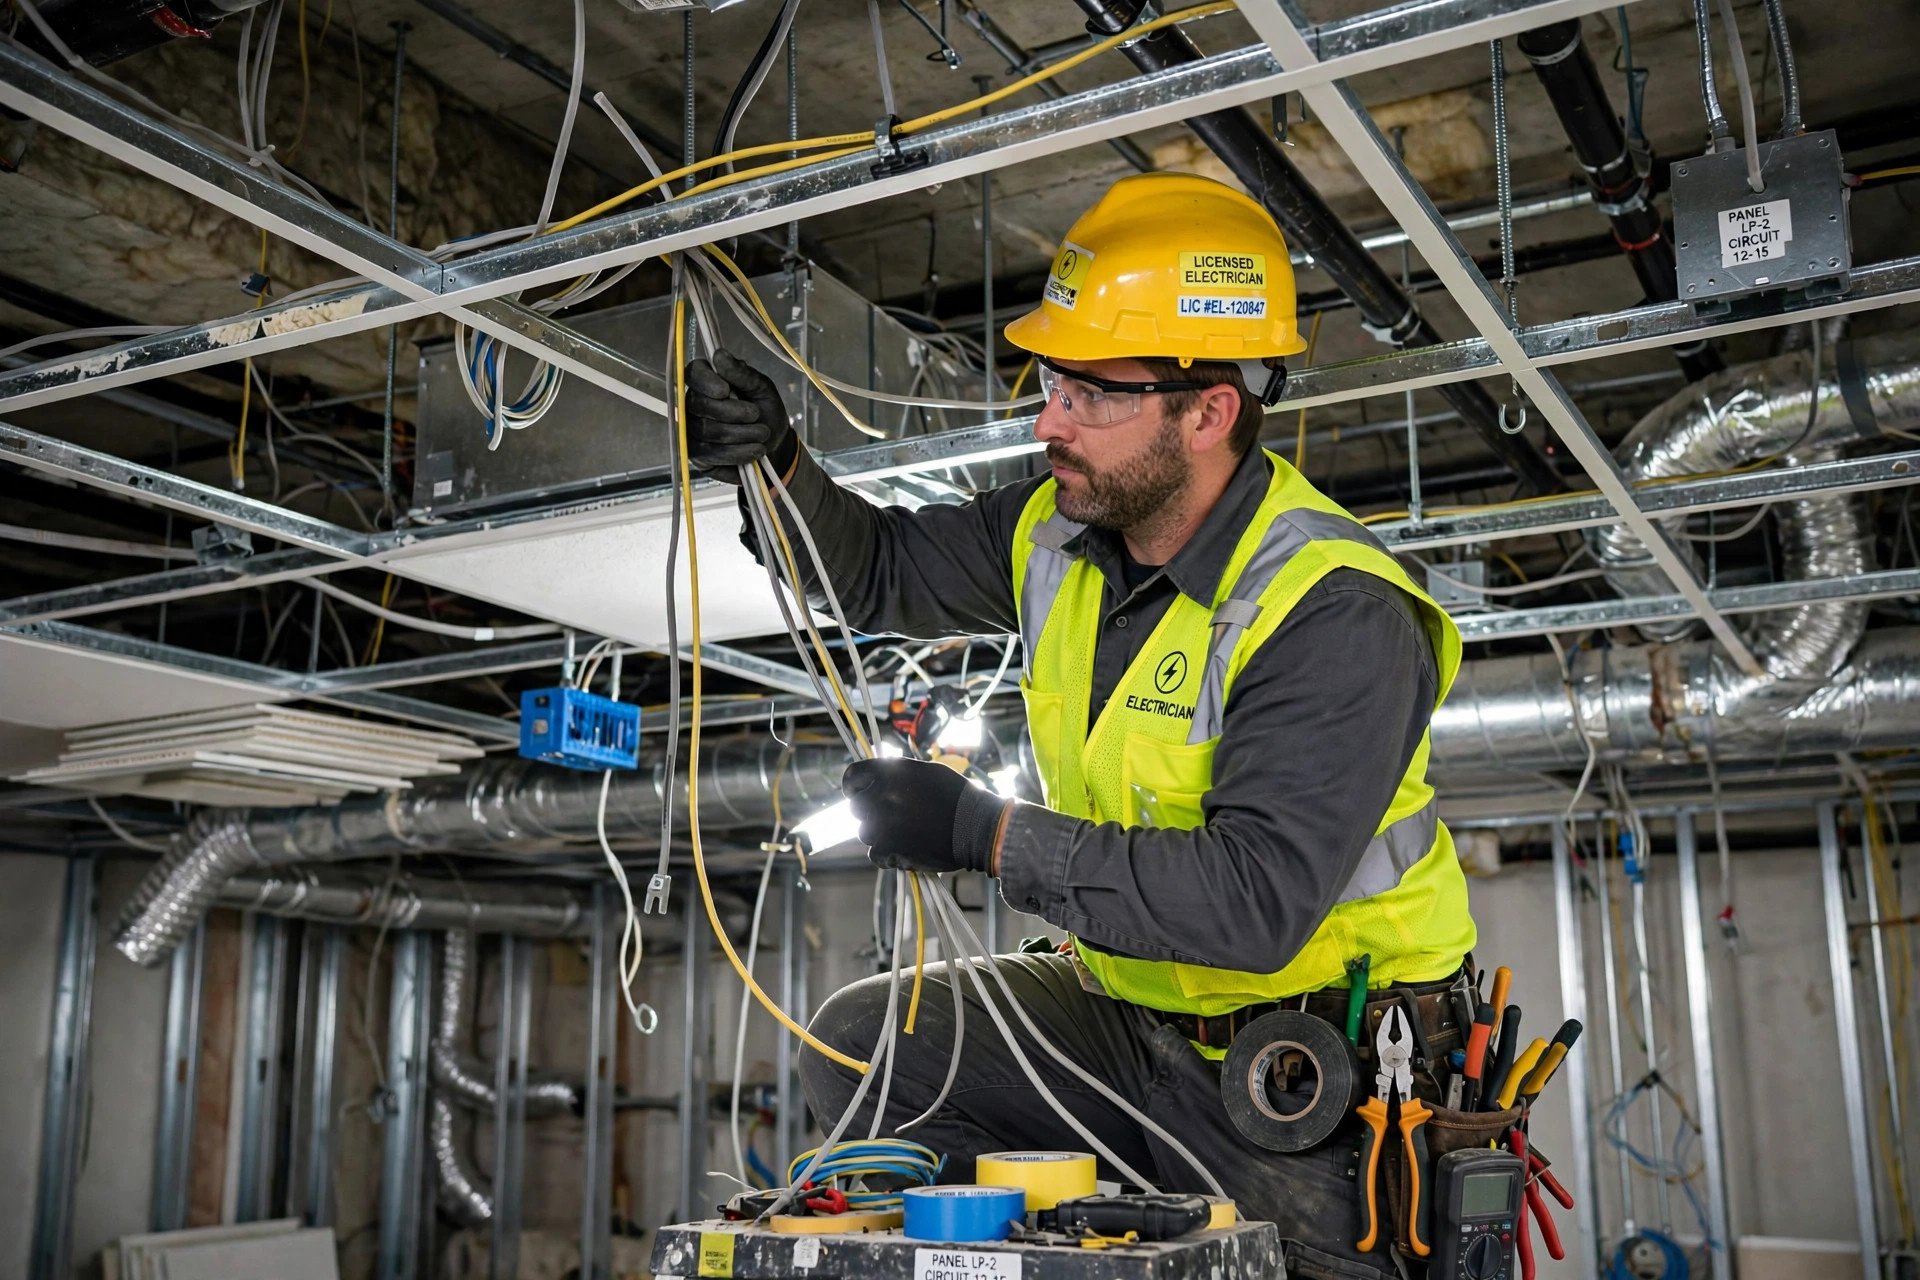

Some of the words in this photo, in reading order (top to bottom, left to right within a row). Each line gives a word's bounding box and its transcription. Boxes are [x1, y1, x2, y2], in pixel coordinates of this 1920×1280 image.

[1728, 206, 1770, 223] PANEL
[1742, 218, 1770, 233] LP-2
[1728, 230, 1780, 249] CIRCUIT
[1733, 246, 1769, 262] 12-15
[1194, 256, 1254, 270] LICENSED
[1185, 271, 1264, 285] ELECTRICIAN
[1181, 299, 1201, 313] LIC
[1204, 300, 1265, 315] #EL-120847
[1125, 695, 1196, 720] ELECTRICIAN
[932, 1253, 968, 1268] PANEL
[971, 1256, 997, 1270] LP-2
[925, 1269, 970, 1280] CIRCUIT
